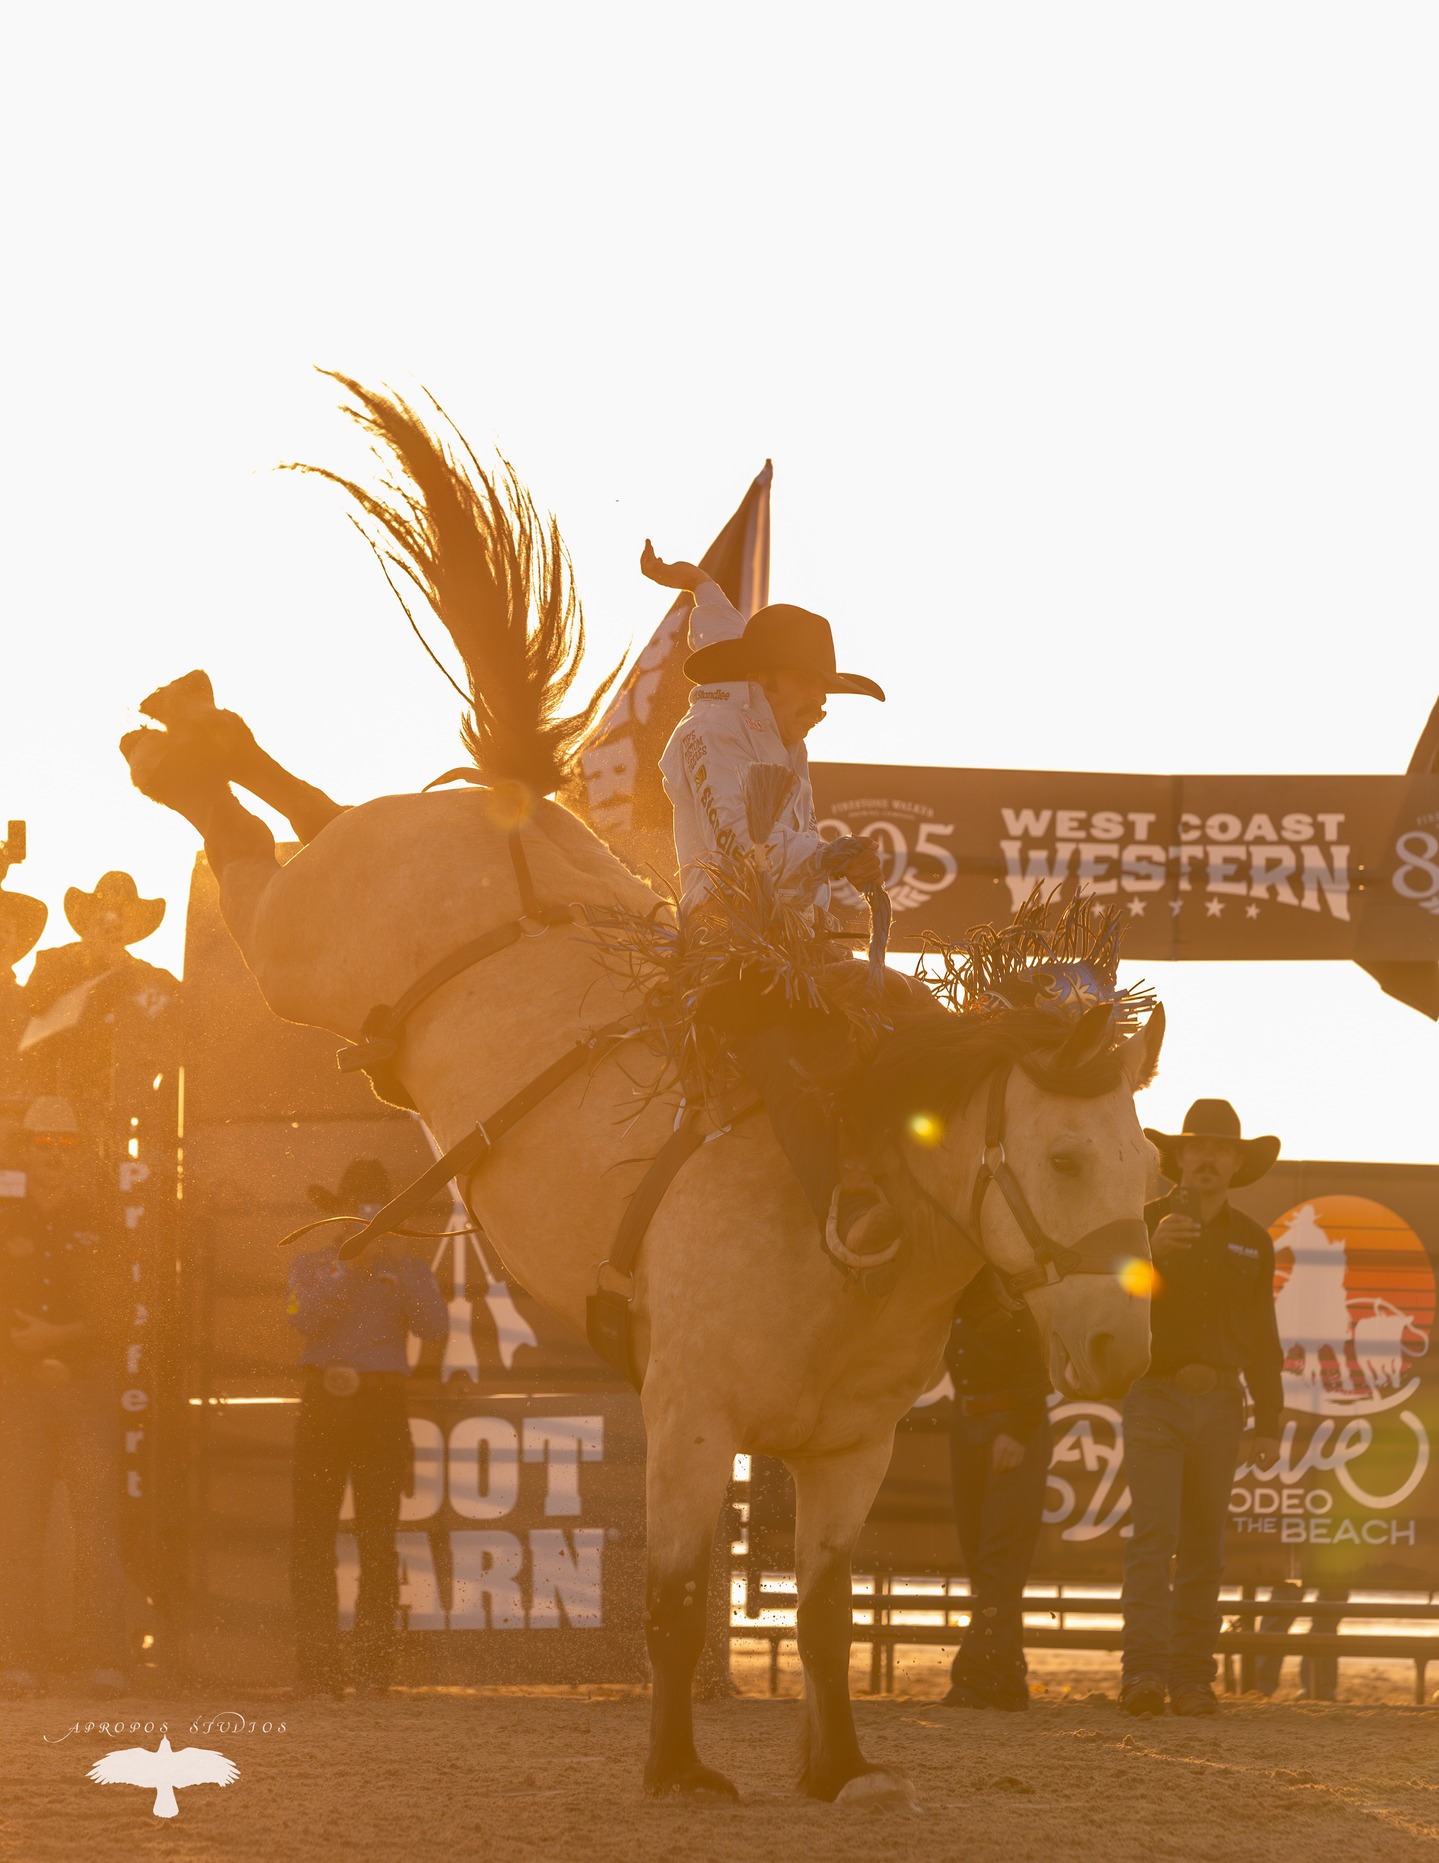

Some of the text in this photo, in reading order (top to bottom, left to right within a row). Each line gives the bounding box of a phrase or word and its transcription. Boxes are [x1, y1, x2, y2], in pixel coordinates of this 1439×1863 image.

[696, 689, 731, 701] Standlee
[700, 786, 756, 860] Standl
[1001, 808, 1346, 842] WEST COAST
[999, 840, 1351, 922] WESTERN
[338, 1415, 605, 1521] OOT
[1228, 1487, 1333, 1515] ODEO
[1232, 1516, 1416, 1546] THE BEACH
[335, 1528, 605, 1631] ARN
